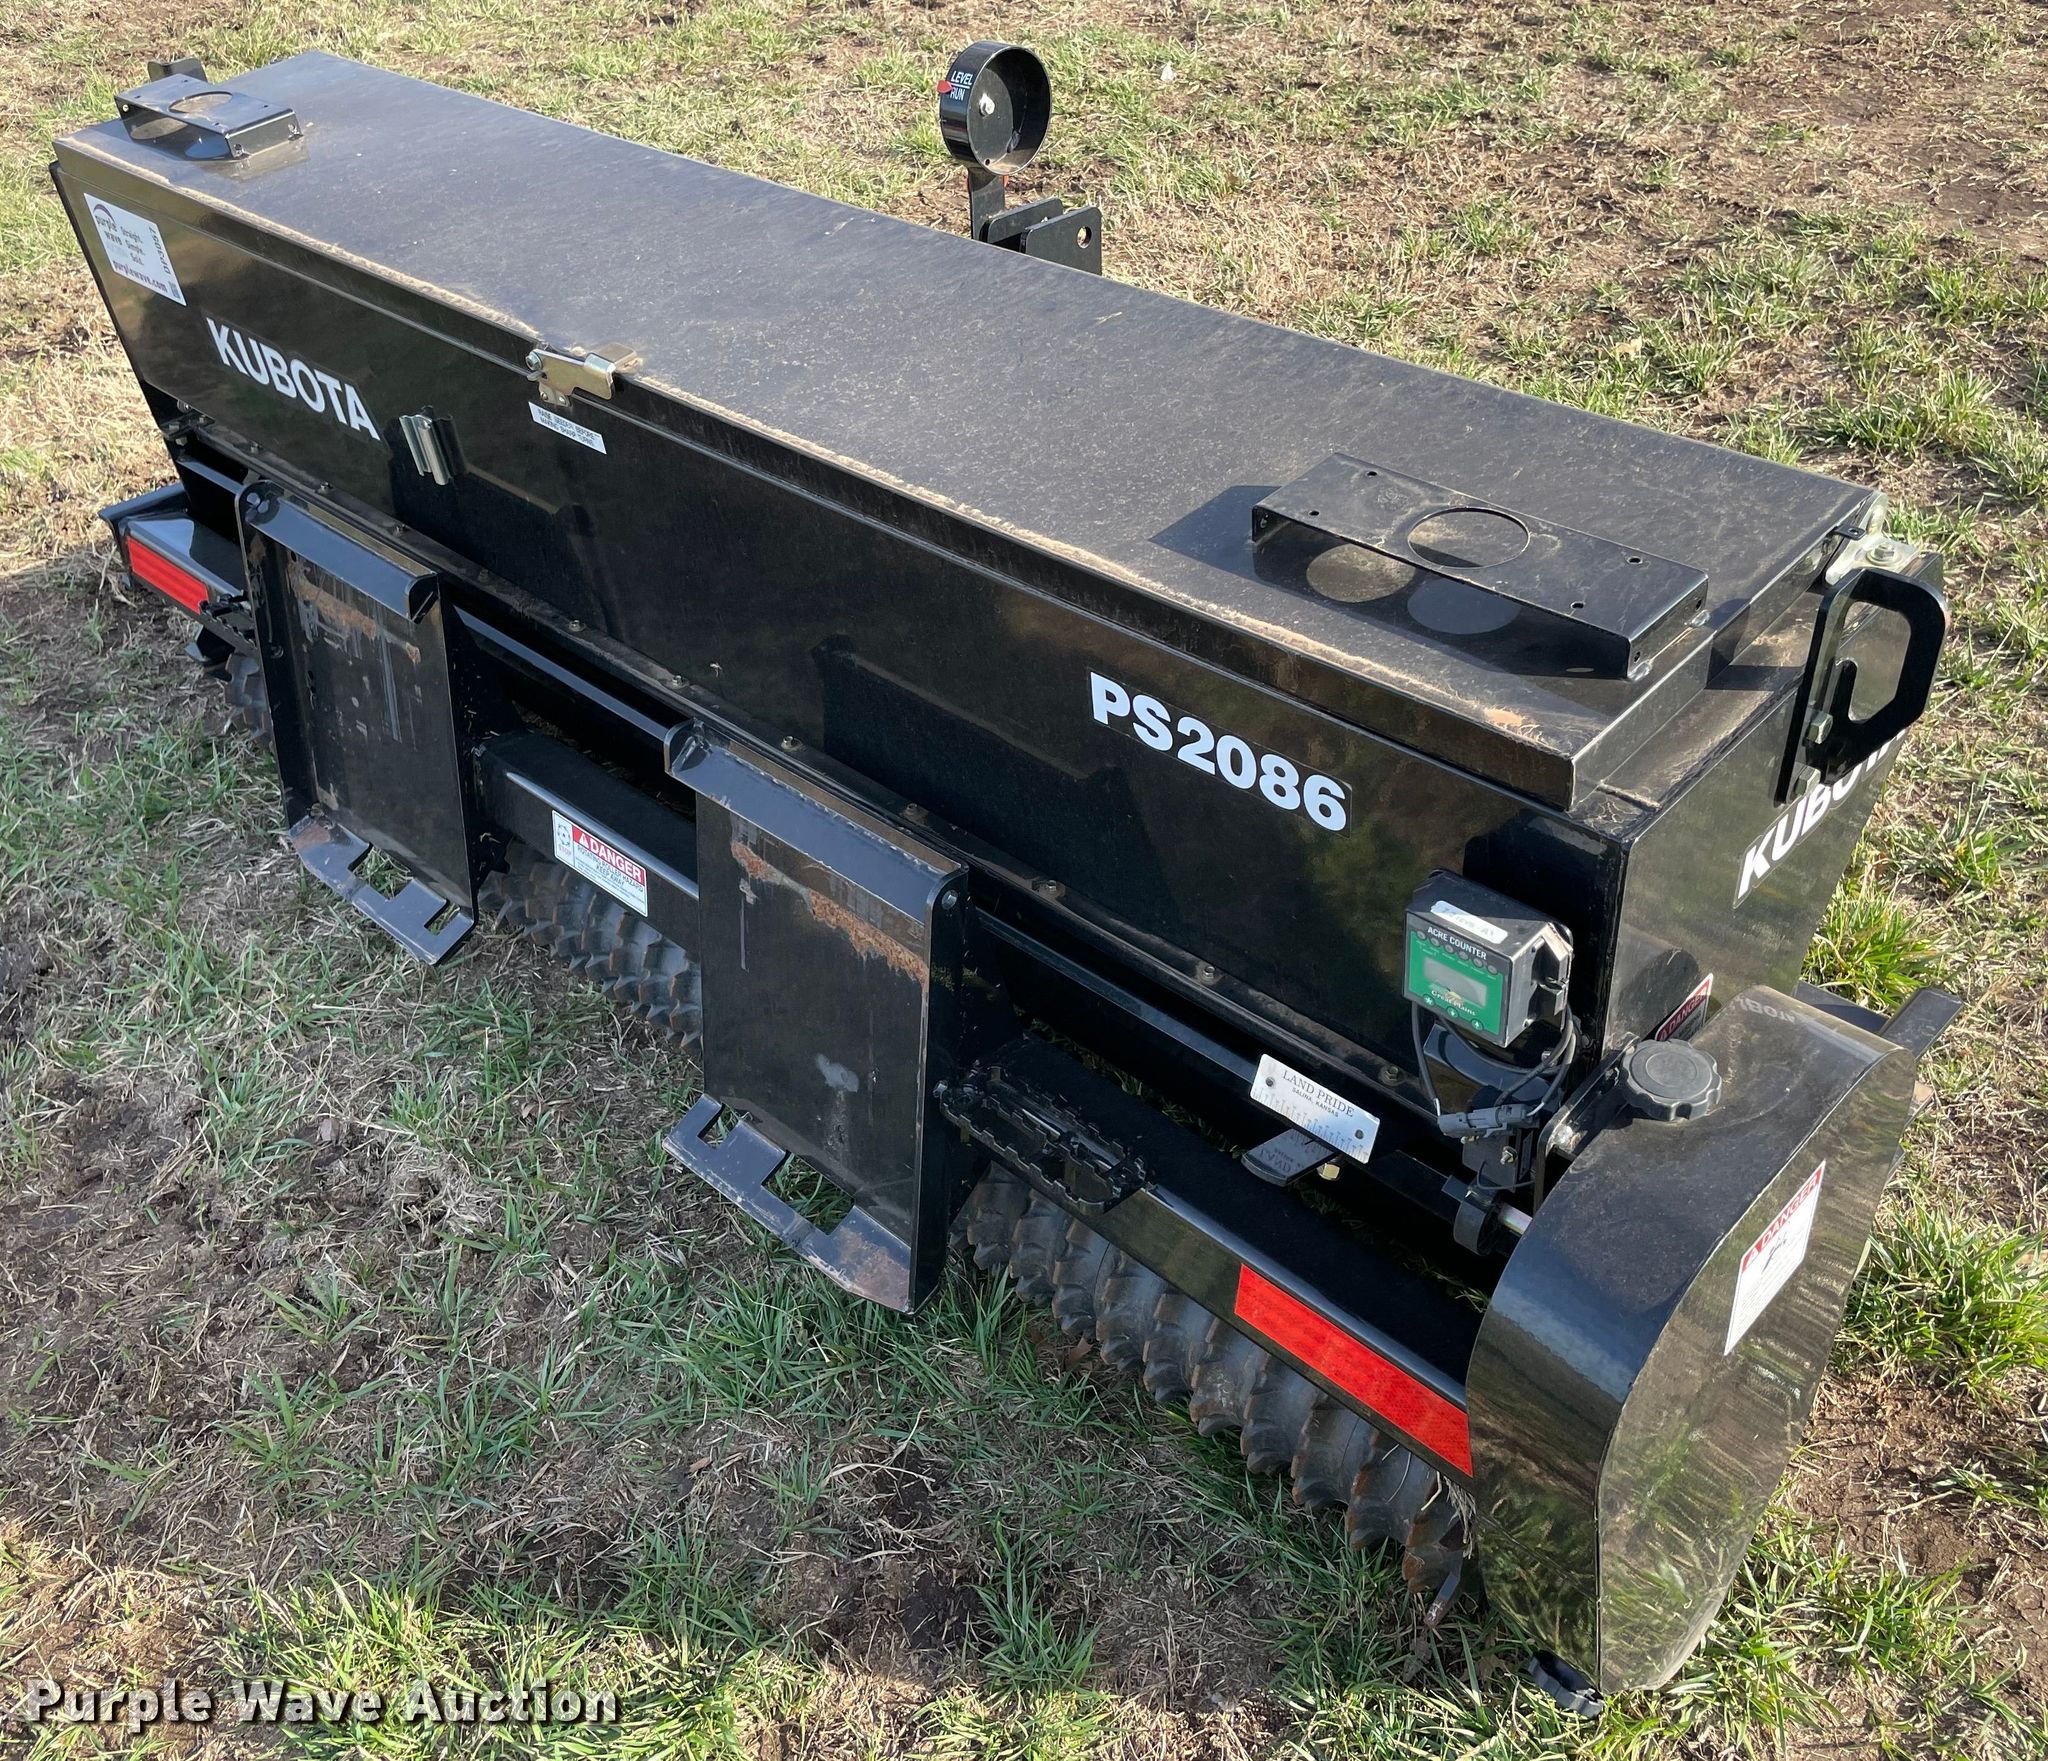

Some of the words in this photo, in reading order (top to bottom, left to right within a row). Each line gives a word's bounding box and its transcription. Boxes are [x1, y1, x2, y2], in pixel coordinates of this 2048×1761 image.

[950, 86, 966, 101] RUN
[951, 71, 974, 85] LEVEL
[94, 214, 118, 232] purple
[112, 259, 168, 293] purplewave.com
[207, 318, 380, 440] KUBOTA
[1091, 672, 1346, 831] PS2086
[590, 838, 641, 882] DANGER
[596, 864, 609, 877] KEEP
[1427, 926, 1447, 941] ACRE
[1449, 937, 1487, 960] COUNTER
[1282, 1070, 1315, 1094] LAND
[1316, 1090, 1354, 1117] PRIDE
[1291, 1087, 1313, 1103] SALINA,
[1315, 1100, 1339, 1117] KANSAS
[1760, 1174, 1817, 1250] DANGER
